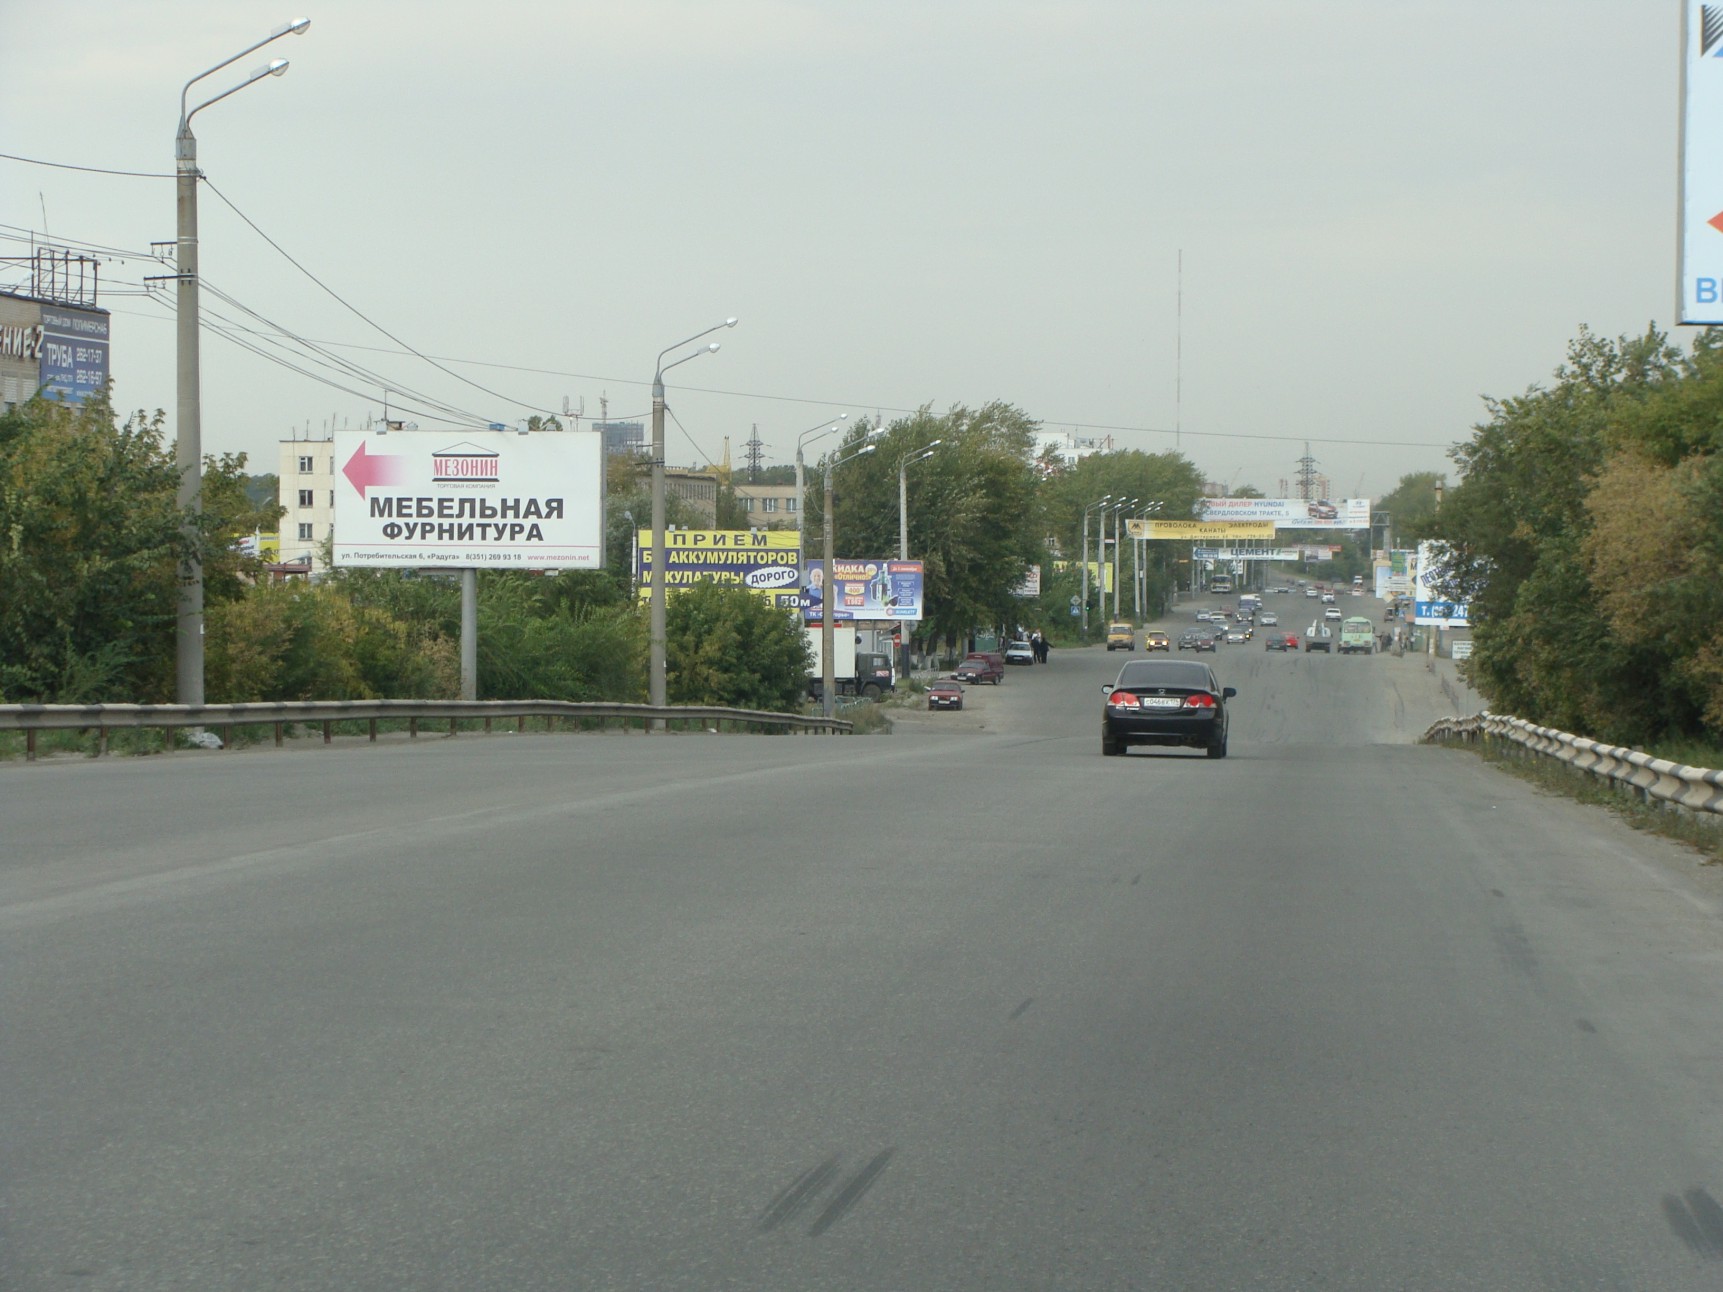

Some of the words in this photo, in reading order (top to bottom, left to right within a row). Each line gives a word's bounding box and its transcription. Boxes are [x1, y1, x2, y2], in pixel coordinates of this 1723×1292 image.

[0, 325, 44, 358] НИЕ-2
[47, 343, 73, 368] ТРУБА
[434, 458, 498, 477] МЕЗОНИН
[370, 497, 564, 519] МЕБЕЛЬНАЯ
[382, 522, 544, 541] ФУРНИТУРА
[673, 534, 767, 546] ПРИЕМ
[354, 552, 417, 560] Потребительская
[427, 553, 460, 561] «Радуга»
[669, 551, 797, 564] АККУМУЛЯТОРОВ
[833, 564, 865, 573] КИДКА
[643, 571, 744, 584] МКУЛАУРЫ!
[751, 570, 795, 585] ДОРОГО
